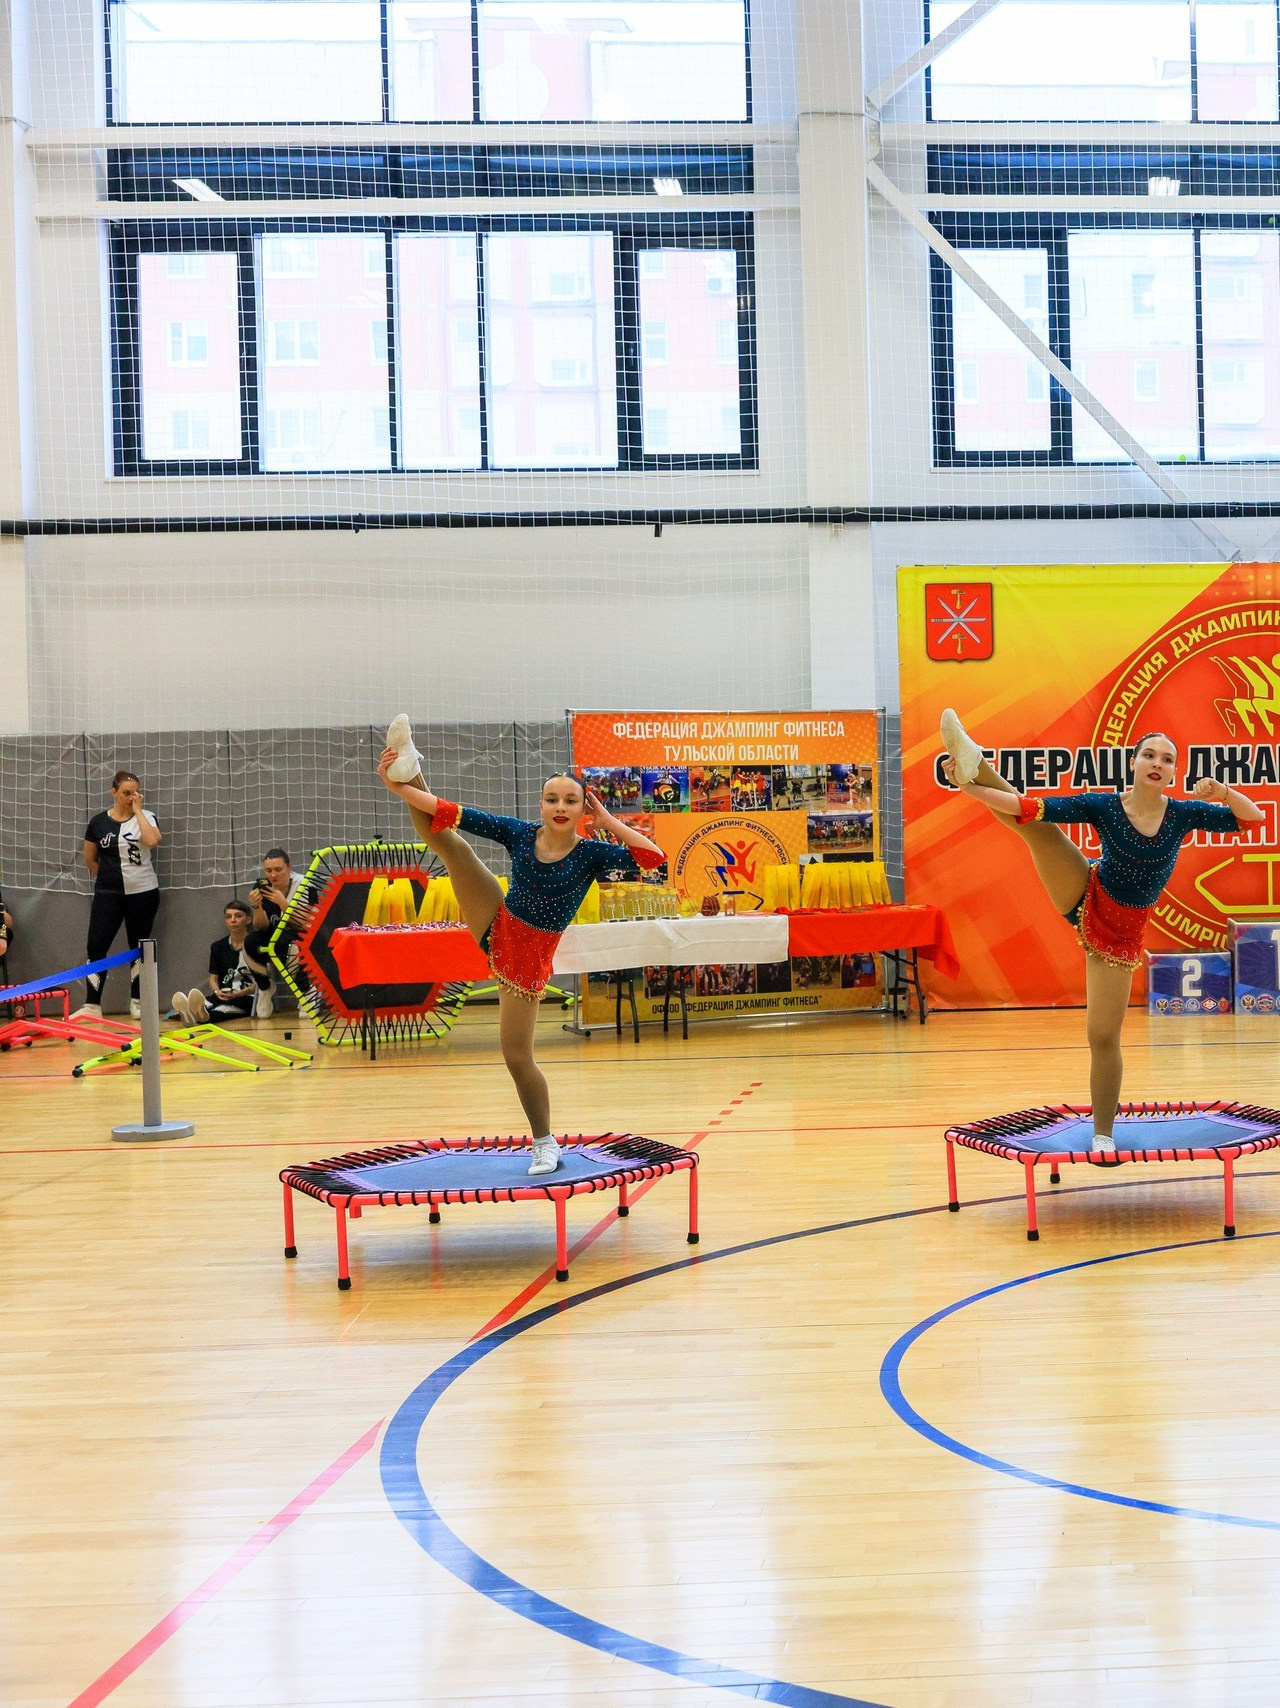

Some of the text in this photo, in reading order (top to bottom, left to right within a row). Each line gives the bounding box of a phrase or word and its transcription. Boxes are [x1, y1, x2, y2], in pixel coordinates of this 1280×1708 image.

[1102, 651, 1168, 746] ДЕРАЦИЯ
[612, 720, 845, 740] ФЕДЕРАЦИЯ ДЖАМПИНГ ФИТНЕСА
[663, 742, 799, 761] ТУЛЬСКОЙ ОБЛАСТИ
[935, 746, 1176, 796] ДЕРАЦ
[676, 819, 788, 876] ФЕДЕРАЦИЯ ДЖАМПИНГ ФИТНЕСА РОСС
[1154, 903, 1228, 948] JUMPI
[1181, 958, 1202, 997] 2
[735, 997, 780, 1011] ДЖАМПИНГ
